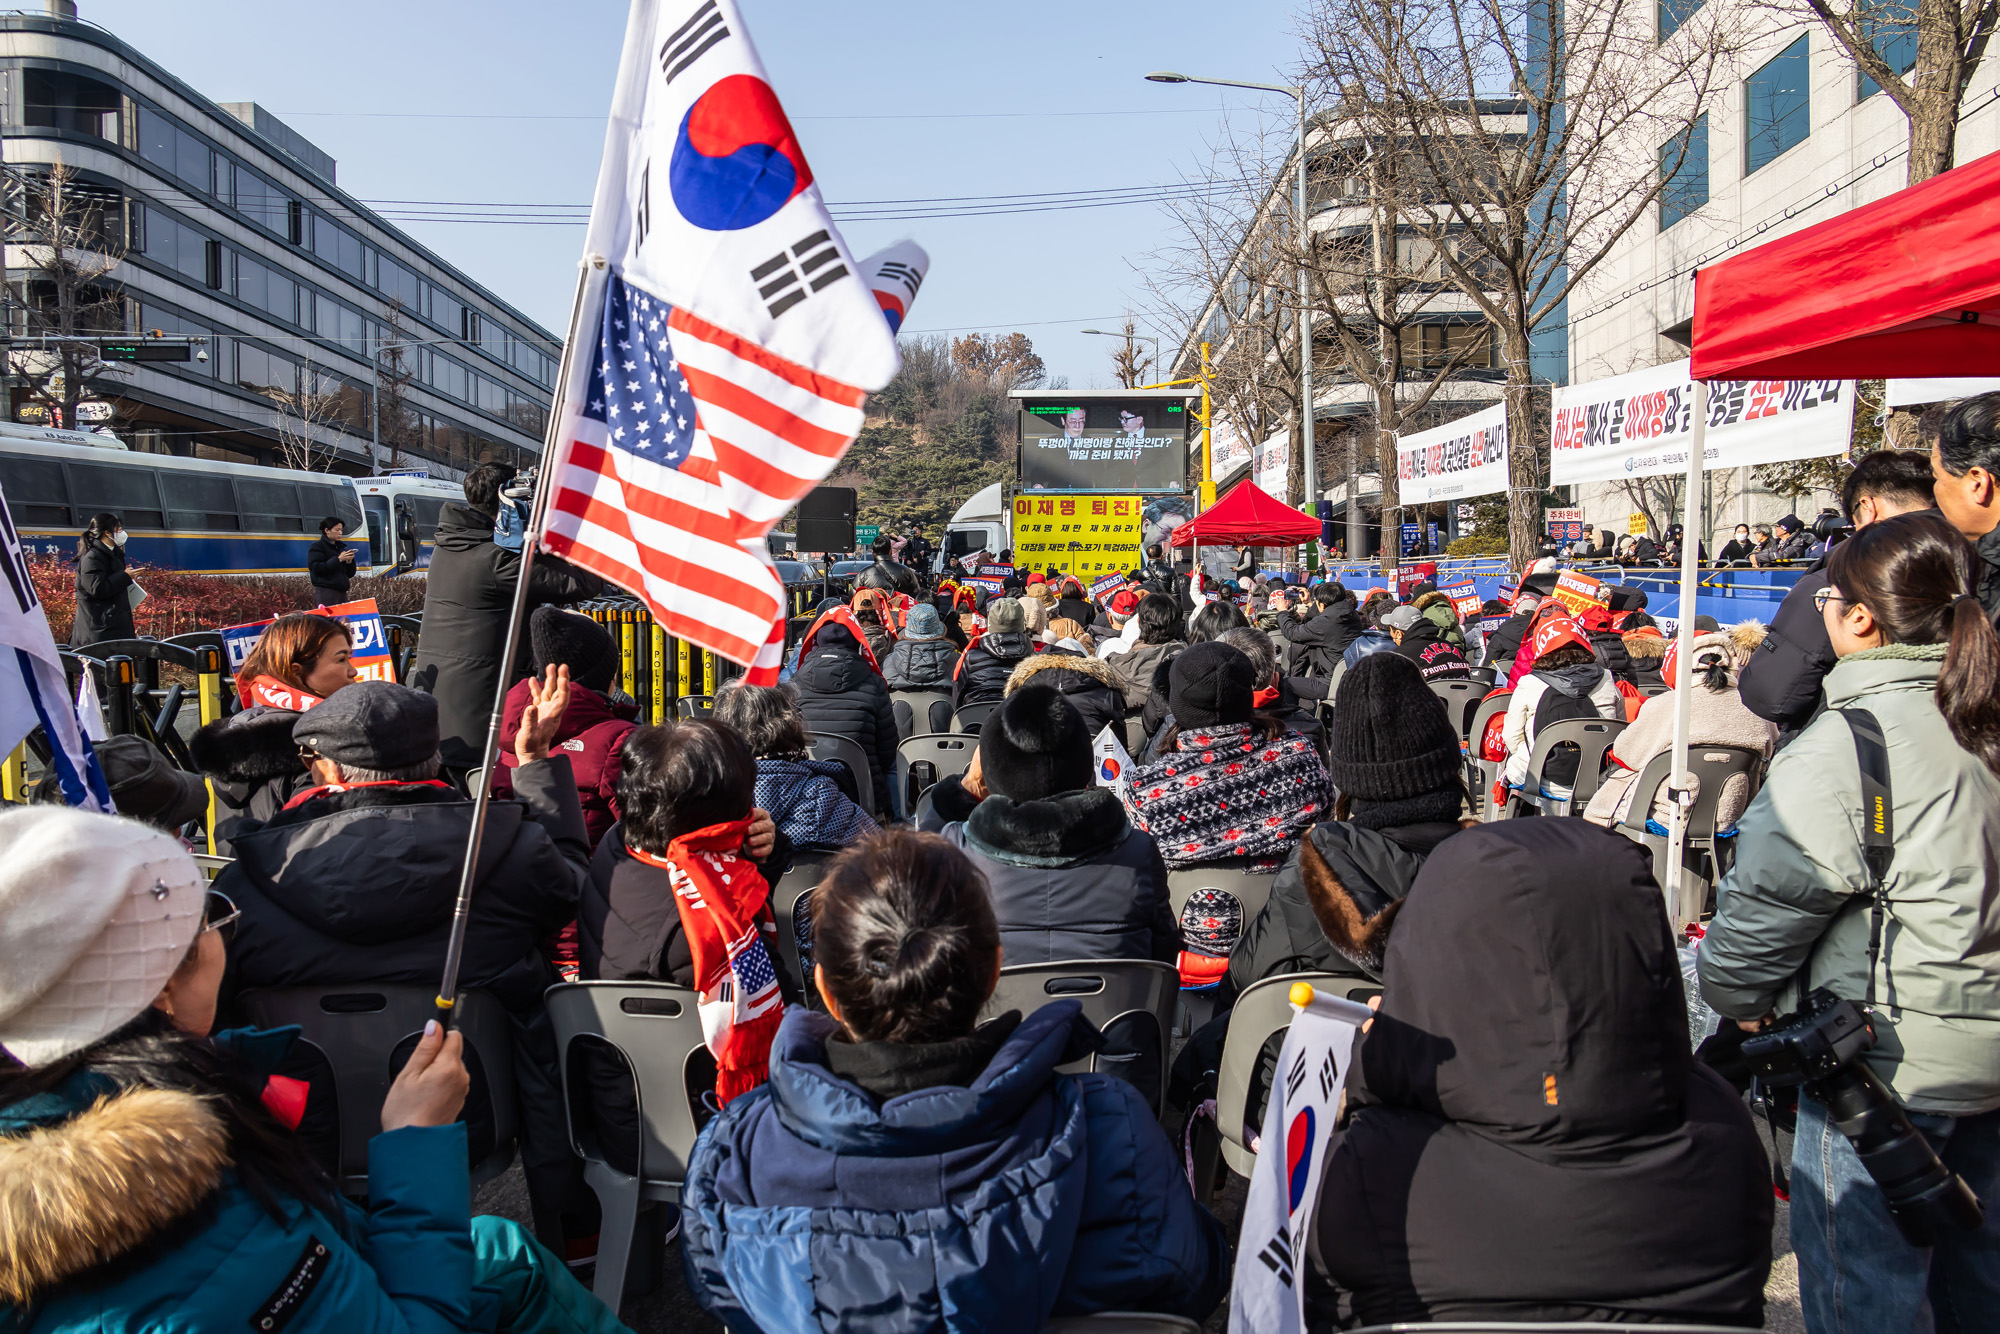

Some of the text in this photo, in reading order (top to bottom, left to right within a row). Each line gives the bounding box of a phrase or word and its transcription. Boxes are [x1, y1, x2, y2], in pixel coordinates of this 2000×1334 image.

[1553, 401, 1610, 451] 하나님께서
[1609, 398, 1626, 445] 곧
[1091, 449, 1111, 460] 준비
[1016, 500, 1140, 516] 이재명 퇴진!
[1549, 510, 1581, 520] 주차완비
[1020, 524, 1140, 532] 이재명 재판 재개하라!
[1549, 523, 1583, 539] 공증
[1020, 543, 1047, 552] 대장동
[1047, 543, 1066, 552] 재판
[1102, 543, 1140, 552] 특검하라!
[1557, 575, 1598, 596] 이재명을
[1557, 592, 1594, 613] 재판하
[349, 618, 384, 650] 포기
[653, 650, 662, 706] POLICE
[1873, 796, 1885, 834] Nikon
